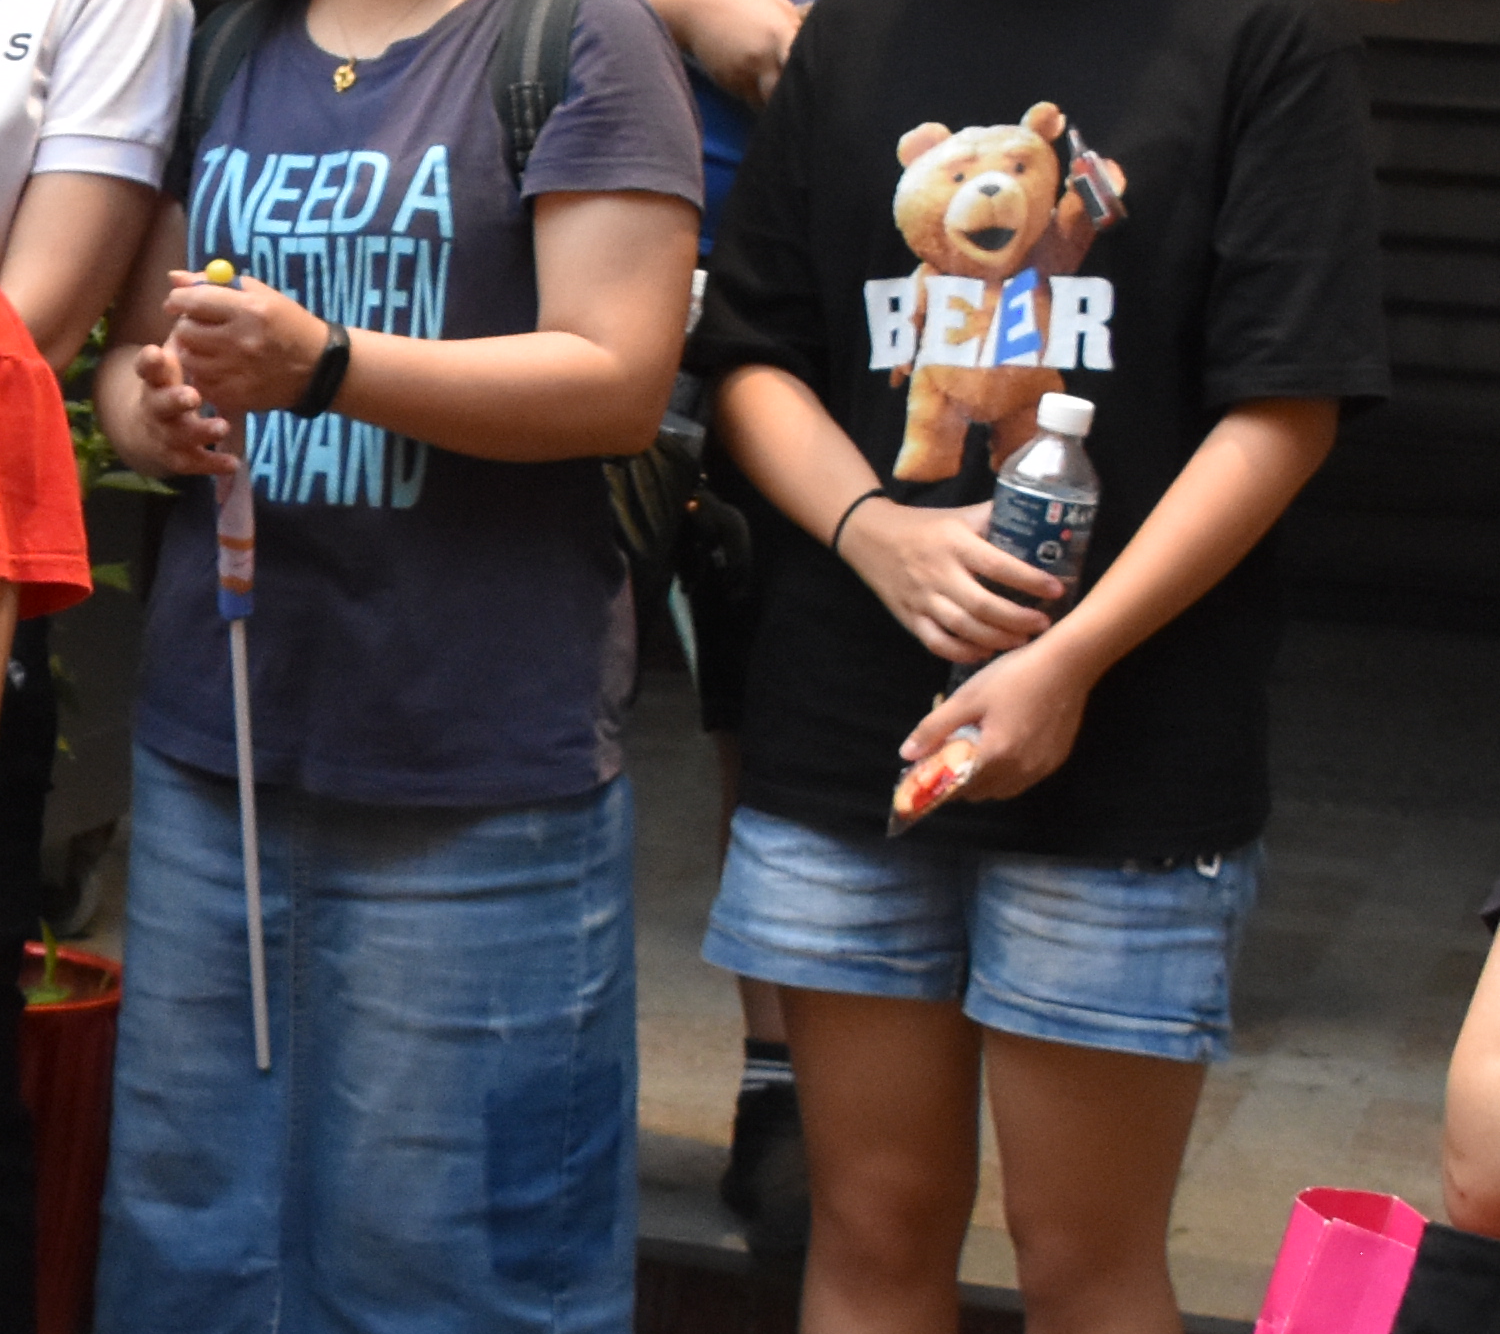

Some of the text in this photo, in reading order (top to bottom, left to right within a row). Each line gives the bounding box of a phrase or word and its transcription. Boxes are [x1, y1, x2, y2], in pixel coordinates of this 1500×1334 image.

[205, 148, 391, 255] NEED
[392, 144, 454, 238] A
[863, 267, 1115, 370] BEER
